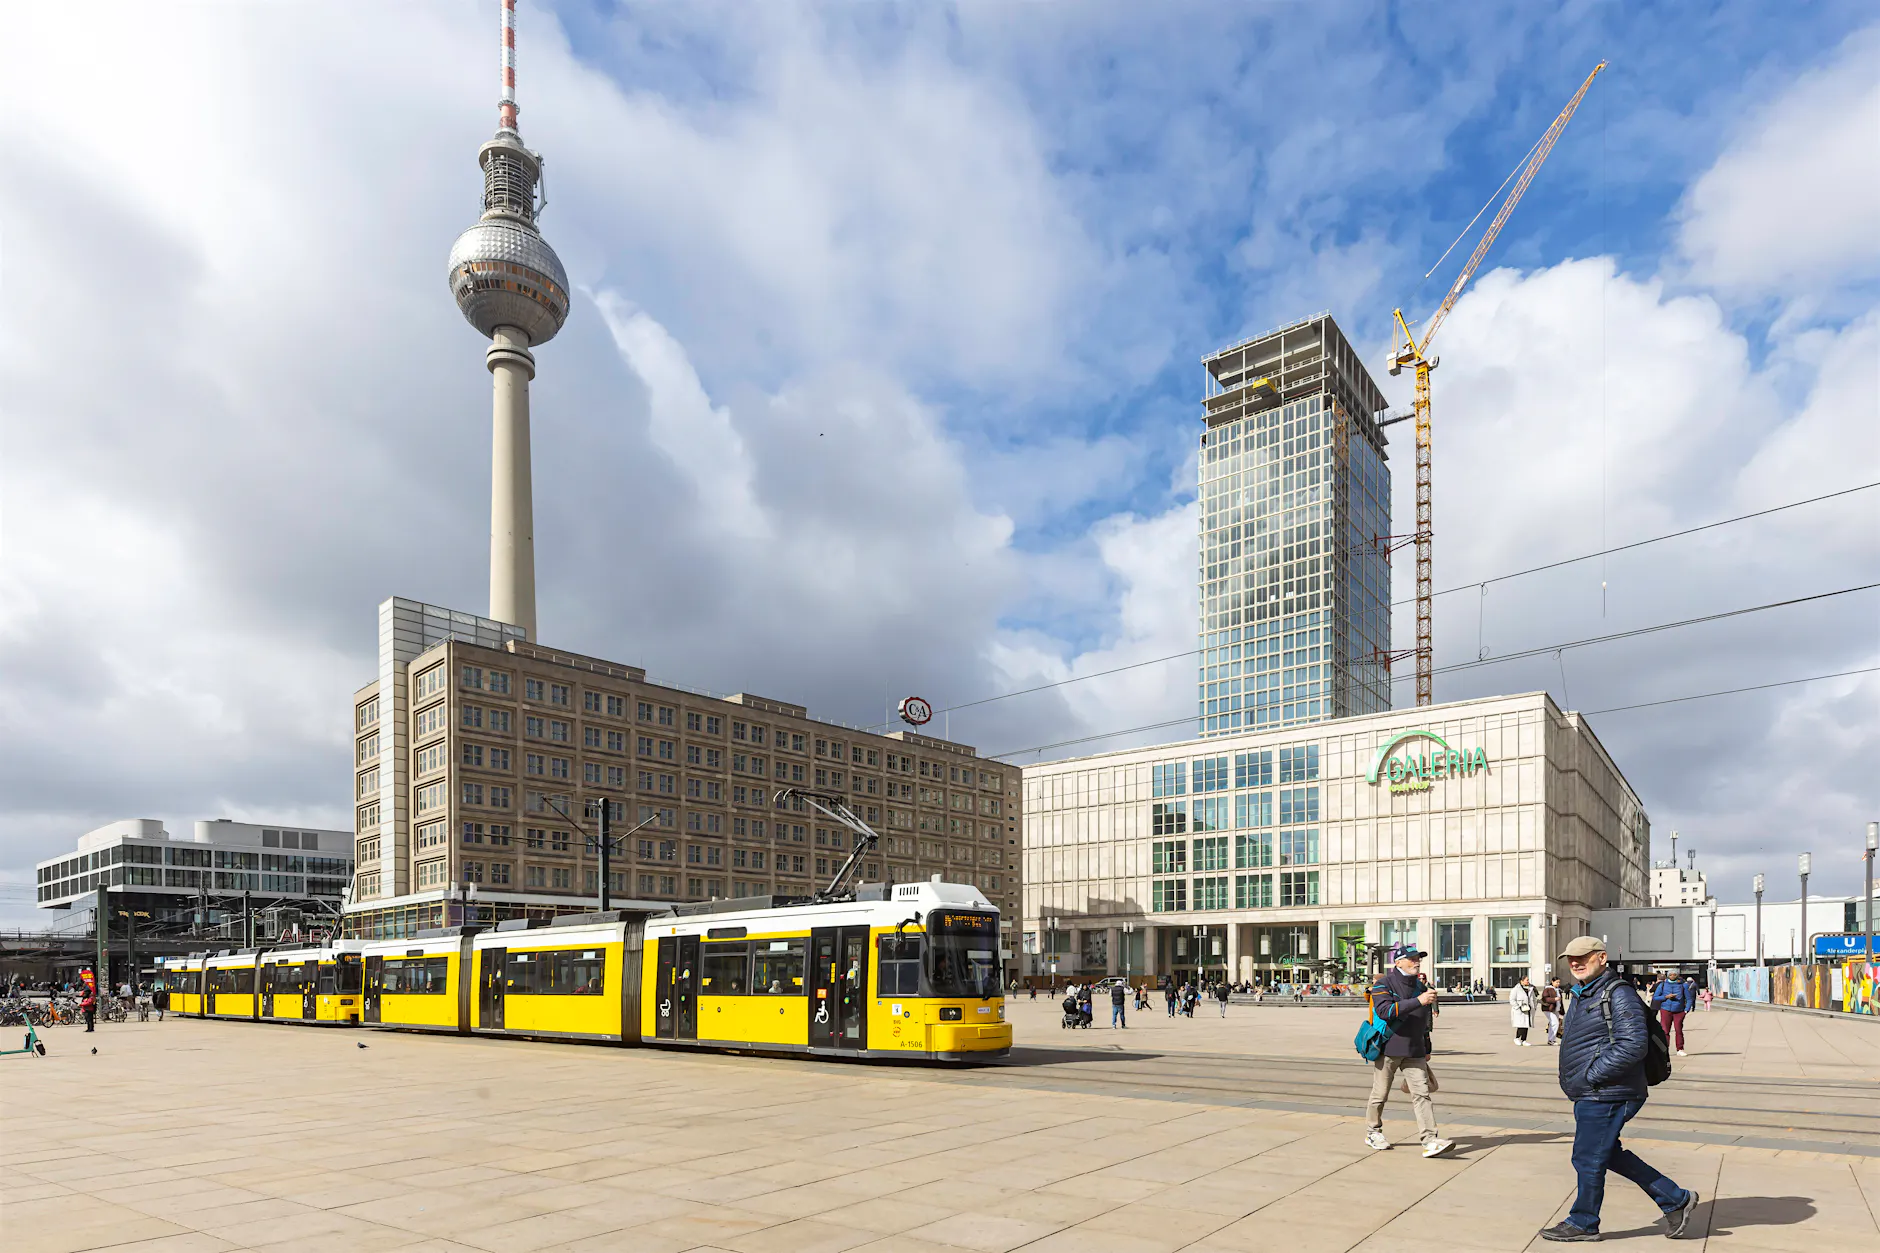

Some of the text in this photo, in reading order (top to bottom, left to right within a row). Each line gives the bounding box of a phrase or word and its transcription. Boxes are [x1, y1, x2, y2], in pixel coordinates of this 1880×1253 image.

[1386, 746, 1488, 781] GALERIA
[1844, 937, 1856, 947] U
[900, 1040, 923, 1048] A-1506
